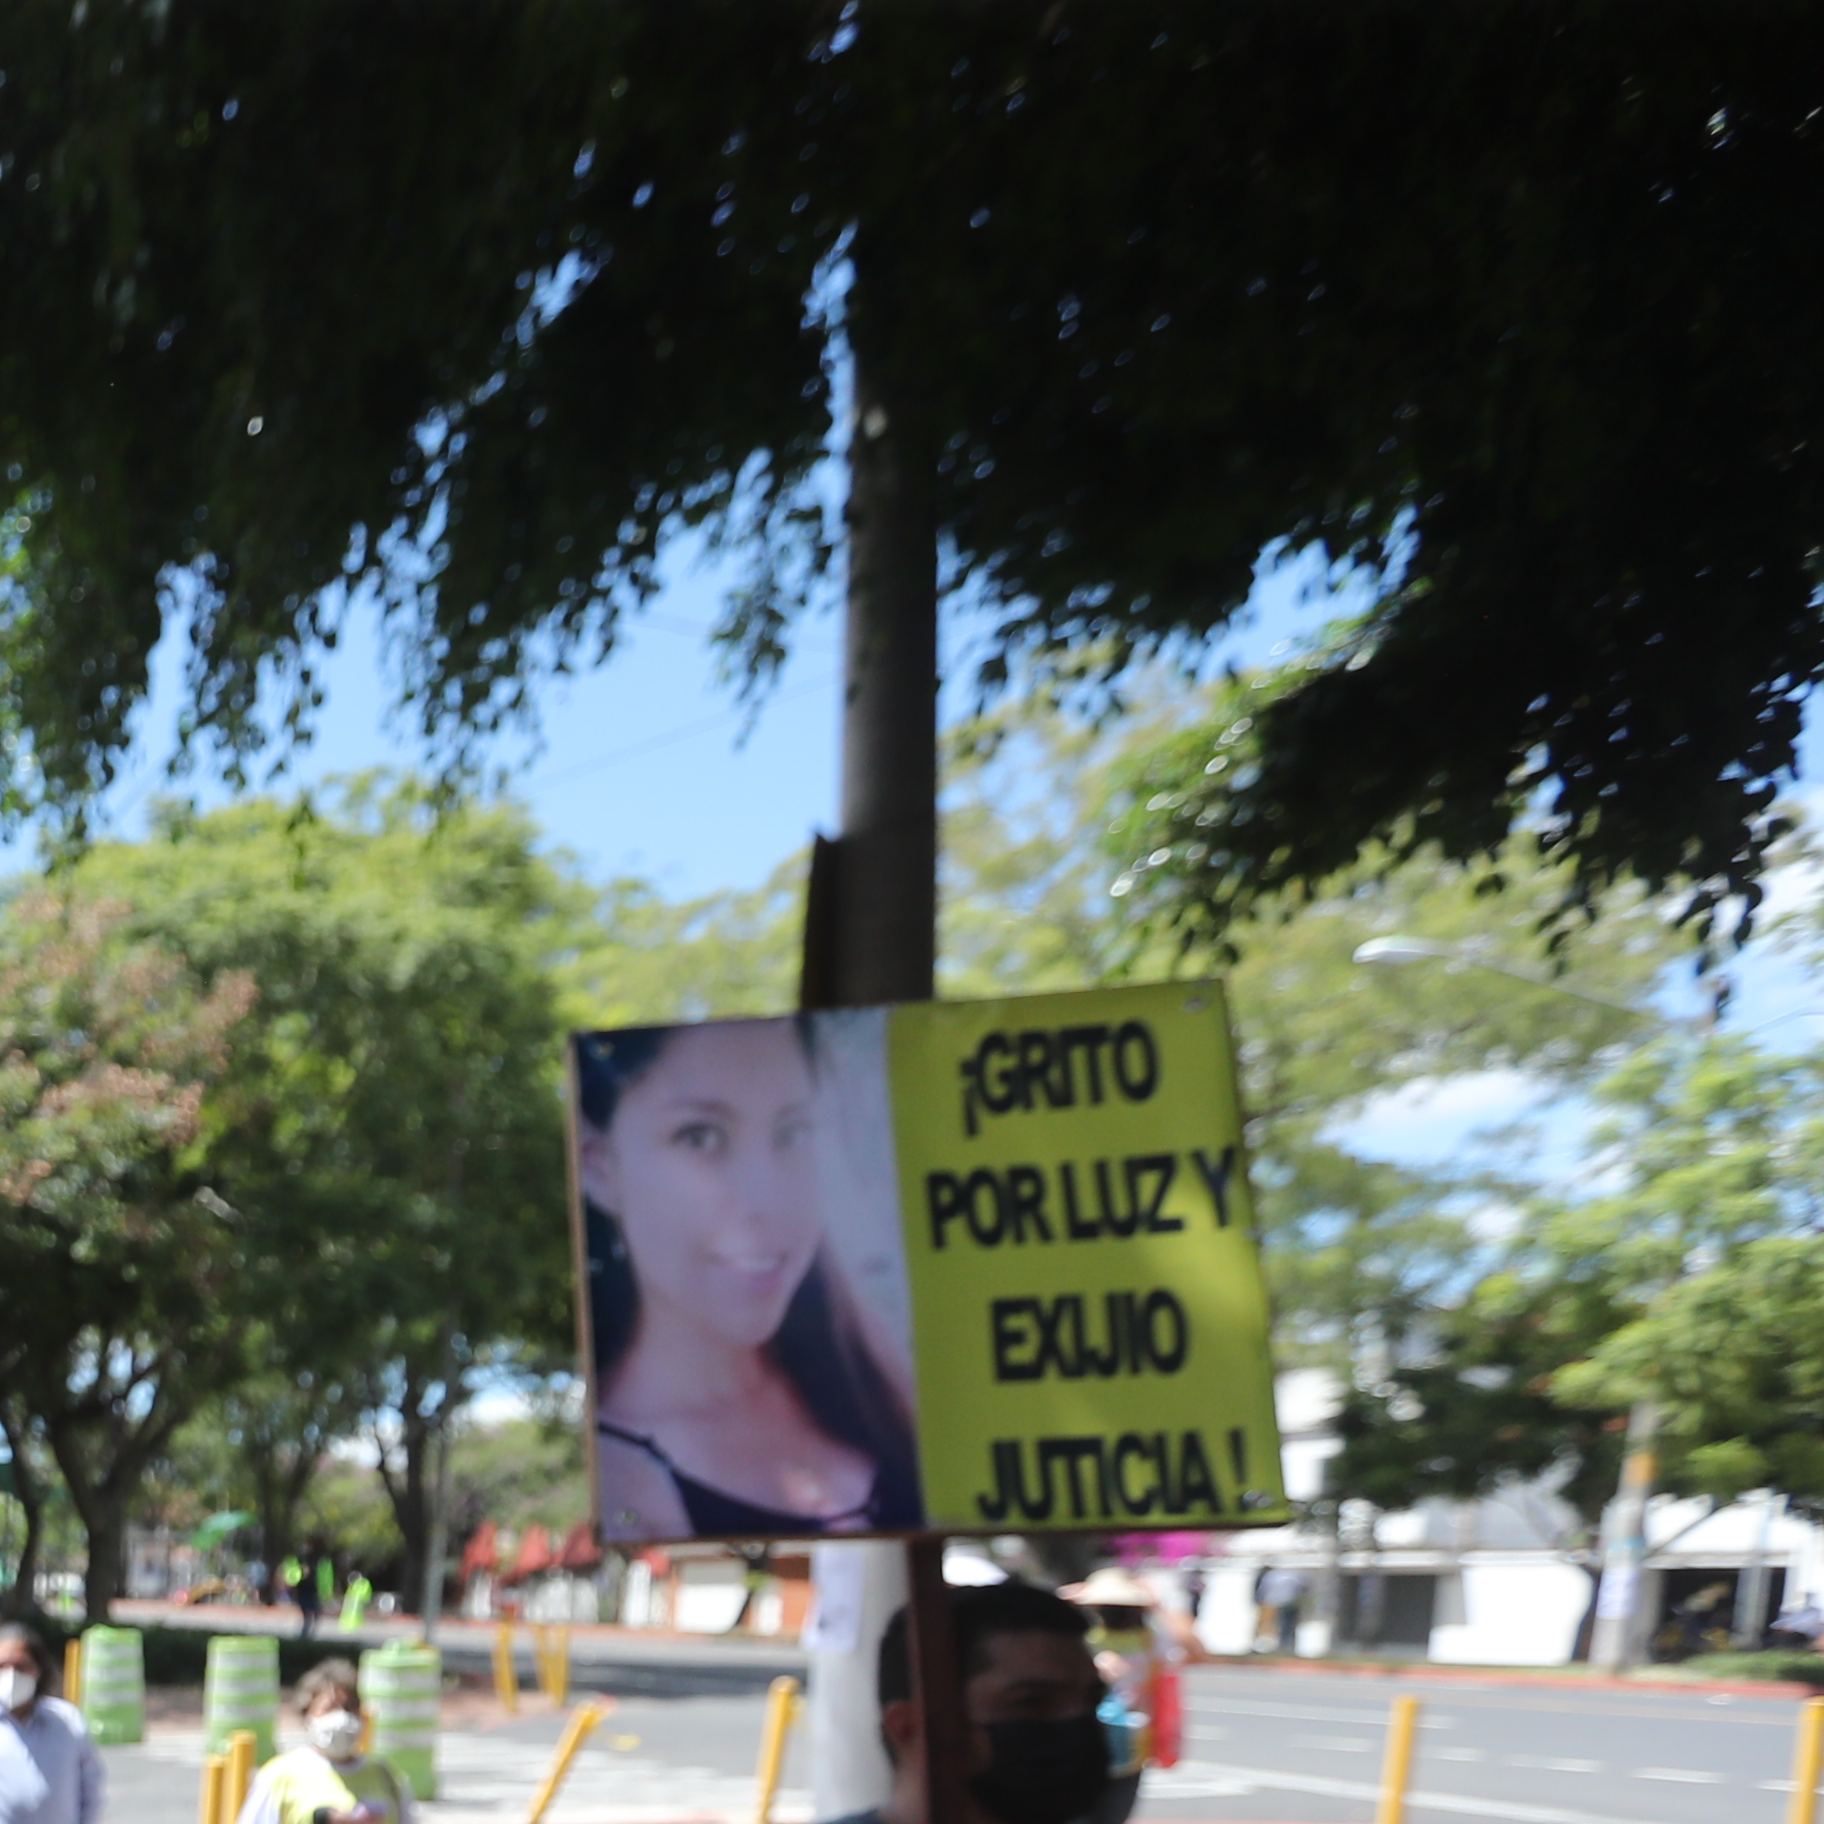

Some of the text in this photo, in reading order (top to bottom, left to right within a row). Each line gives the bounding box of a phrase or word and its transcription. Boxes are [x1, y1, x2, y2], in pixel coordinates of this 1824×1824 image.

[960, 1020, 1160, 1138] ¡GRITO
[924, 1143, 1238, 1252] POR LUZ Y
[989, 1288, 1190, 1384] EXIJIO
